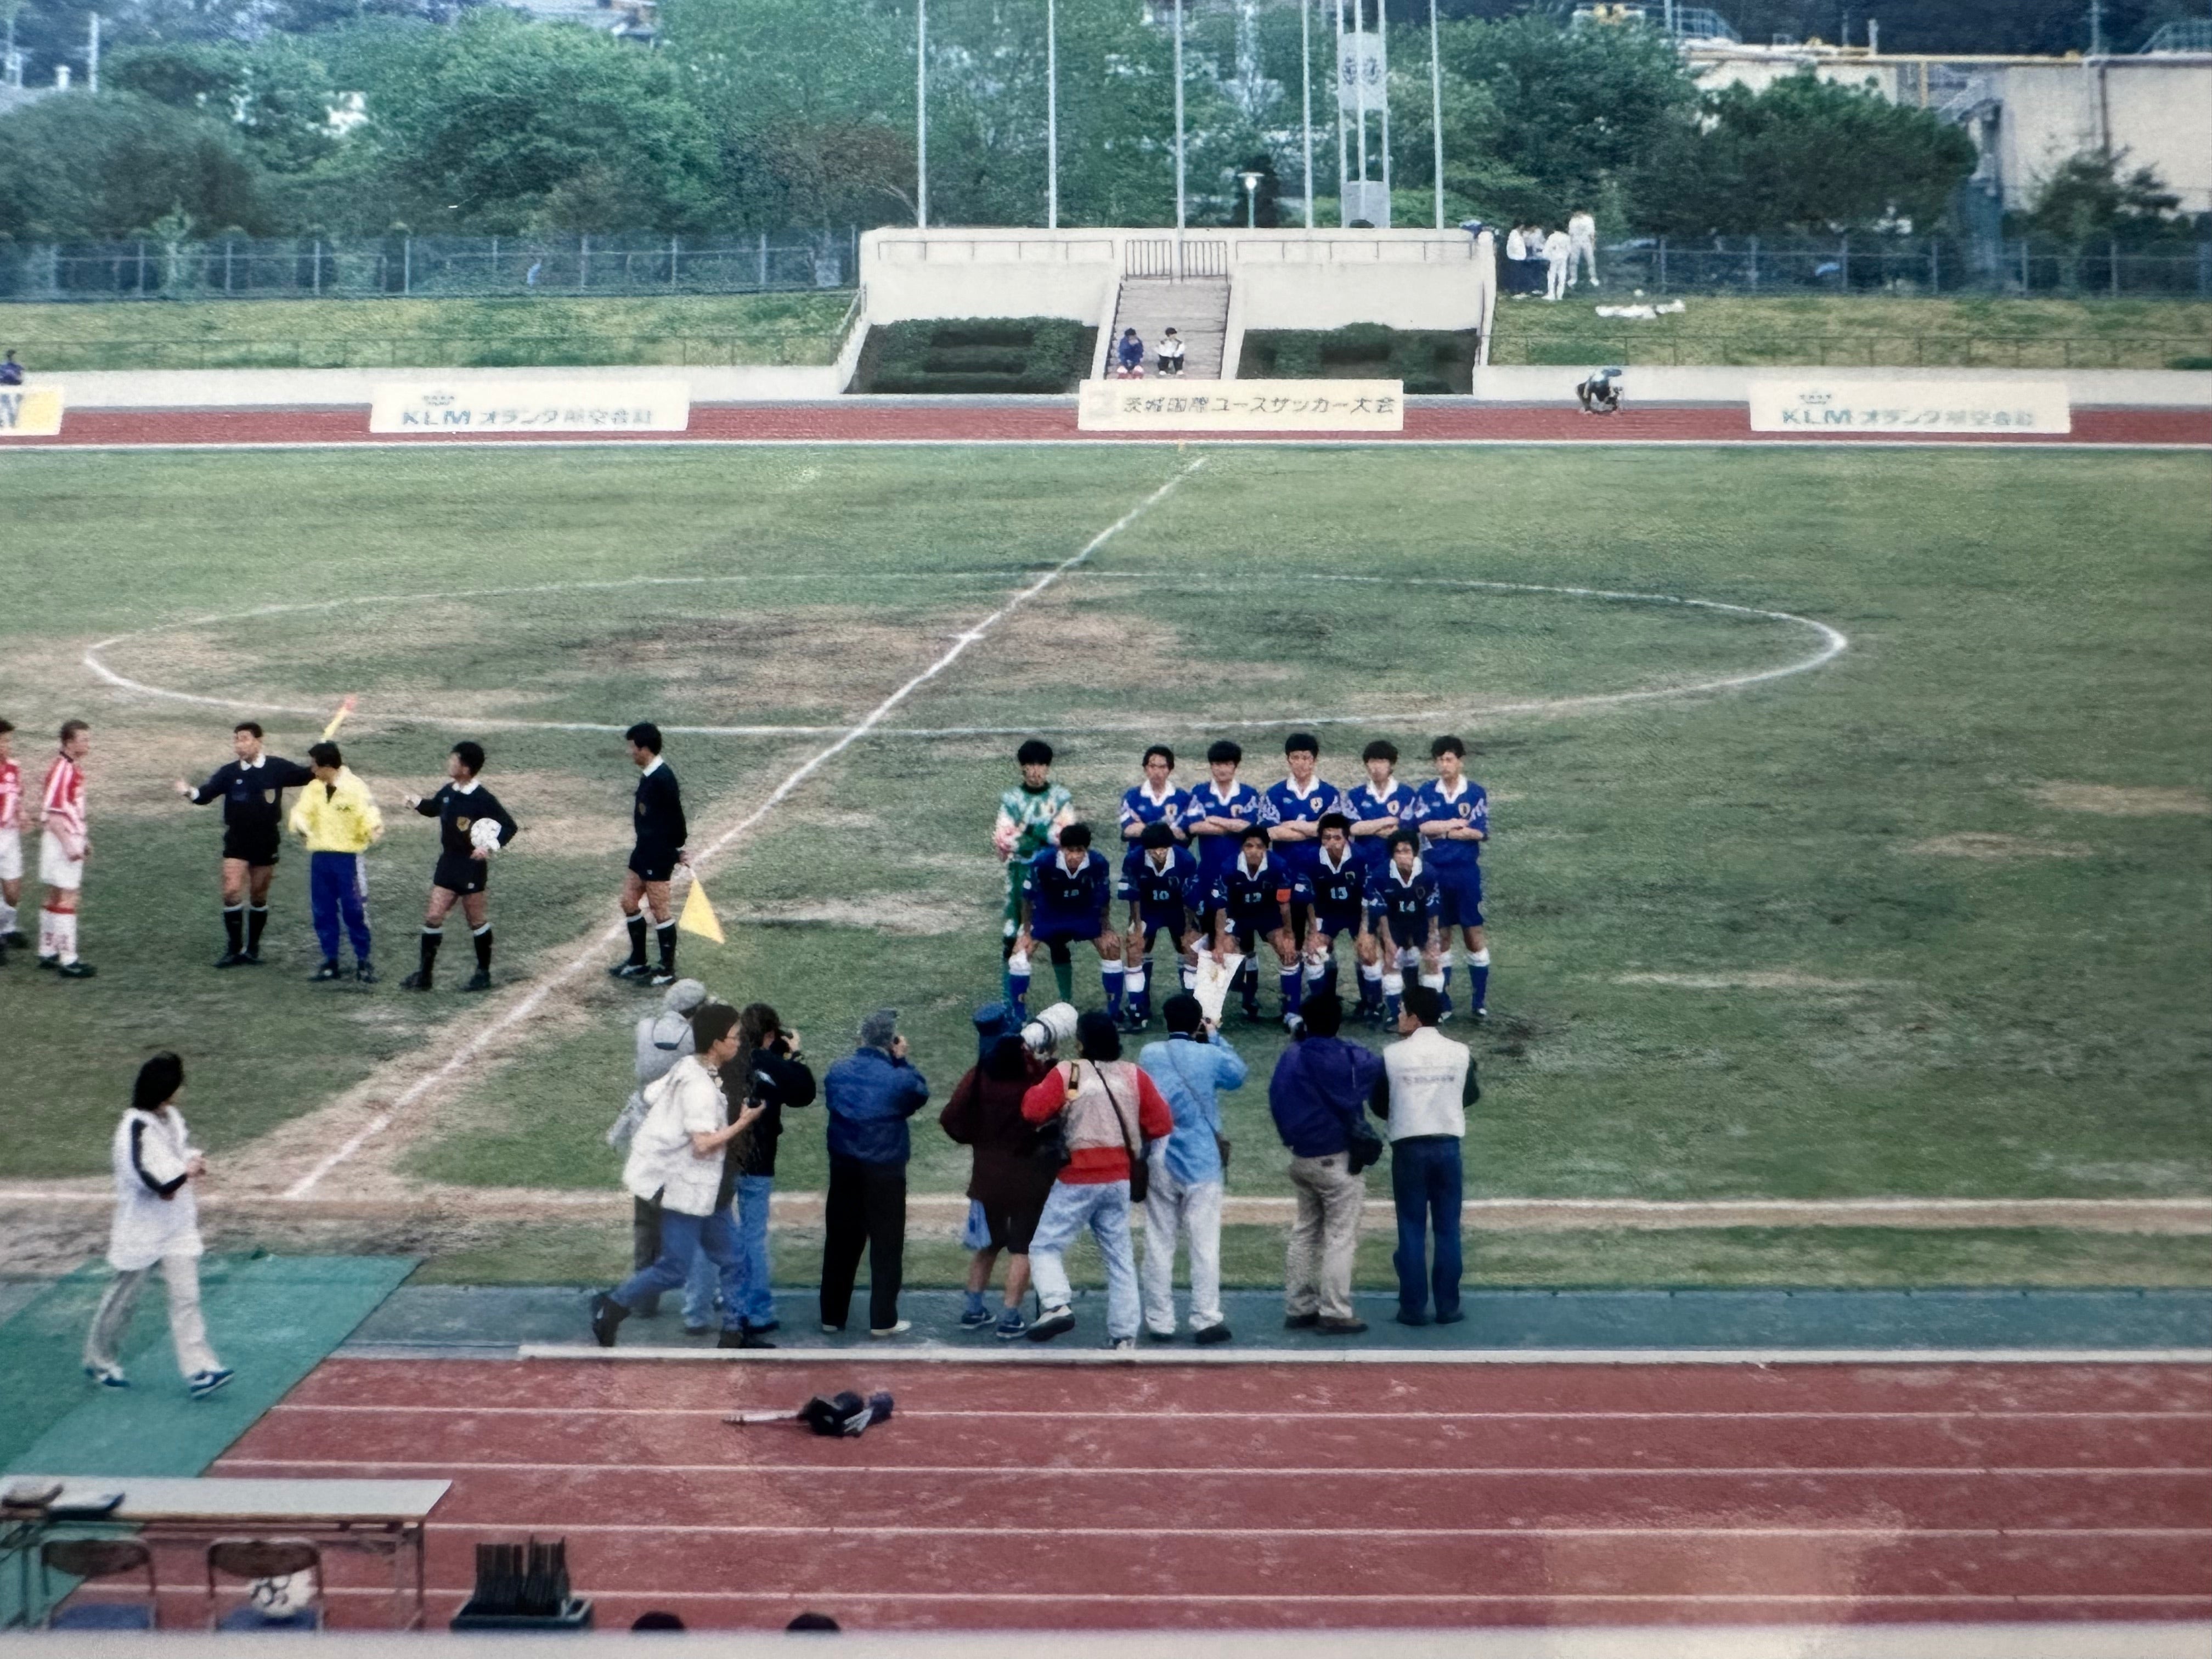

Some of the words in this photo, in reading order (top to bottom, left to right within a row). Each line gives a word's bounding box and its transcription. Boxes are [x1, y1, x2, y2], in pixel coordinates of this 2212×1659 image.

[403, 410, 471, 425] KLM
[1782, 409, 1852, 425] KLM
[1152, 889, 1170, 901] 10
